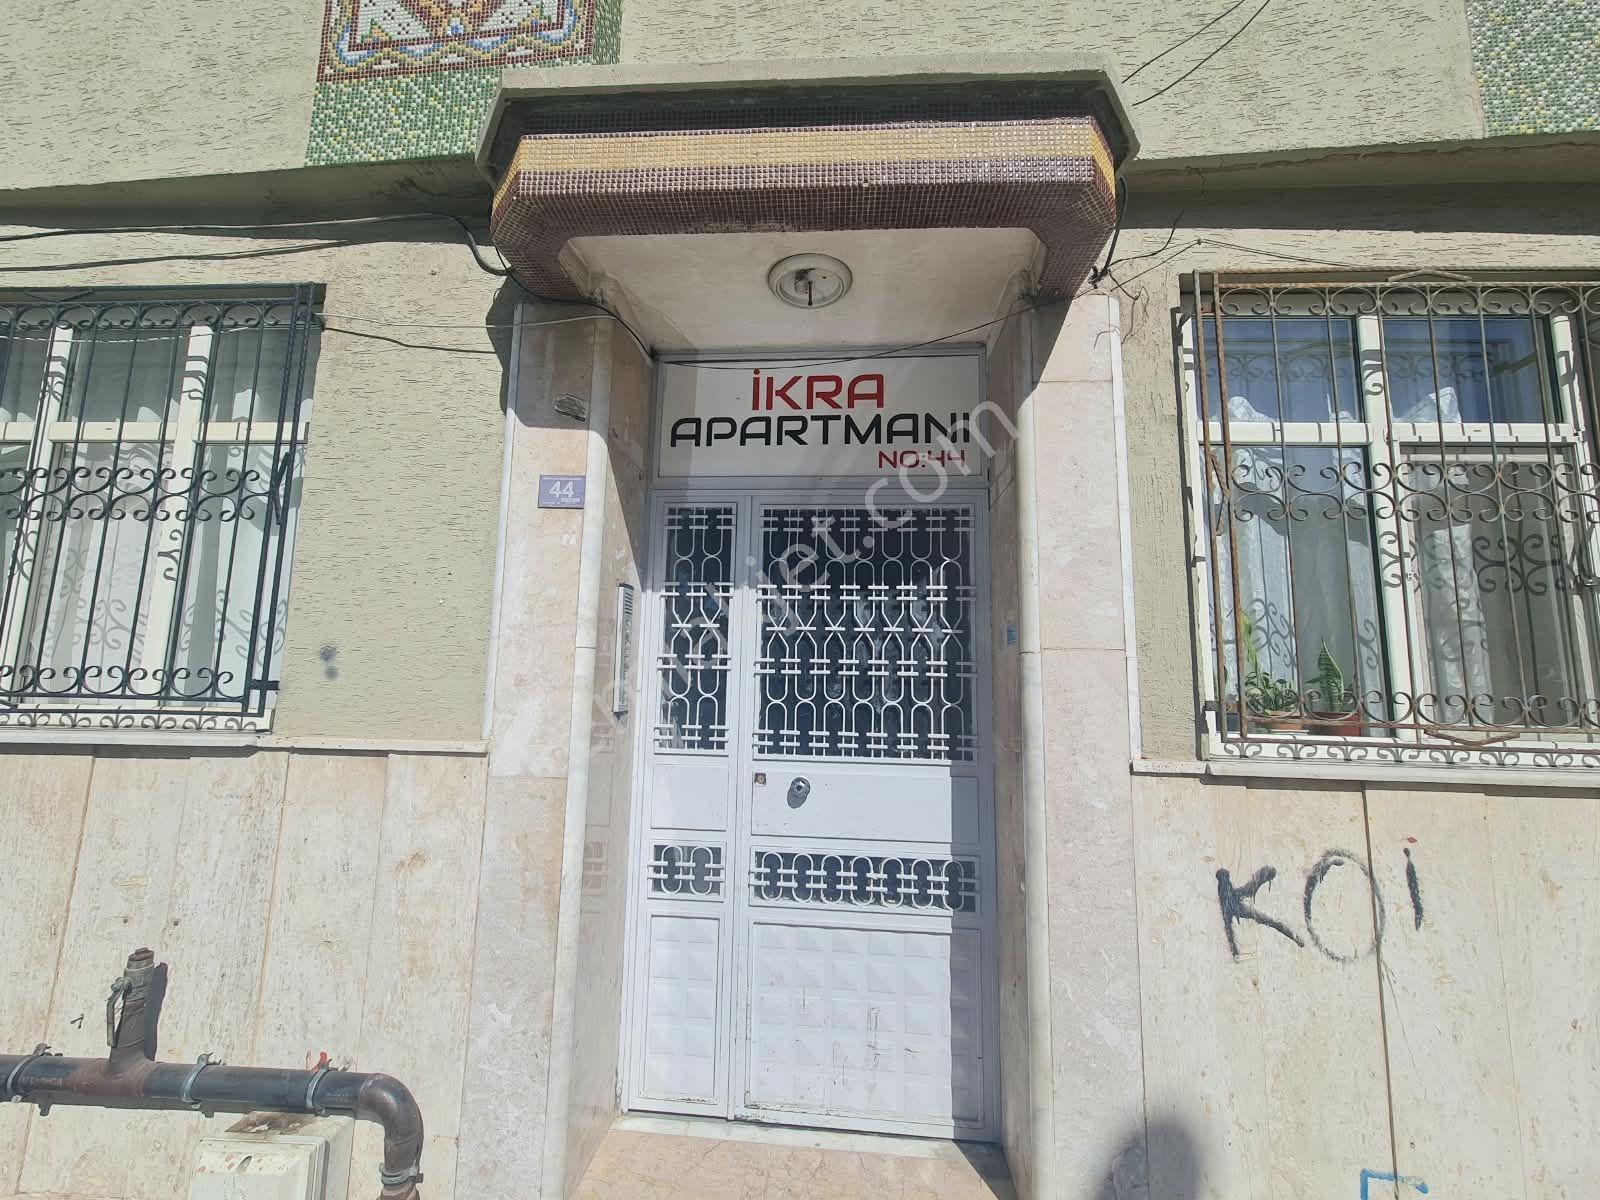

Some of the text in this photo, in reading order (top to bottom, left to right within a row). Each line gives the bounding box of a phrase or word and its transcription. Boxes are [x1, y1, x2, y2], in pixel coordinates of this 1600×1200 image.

[752, 368, 884, 411] İKRA
[670, 412, 970, 448] APARTMANI
[878, 449, 966, 469] NO:44
[549, 480, 575, 498] 44
